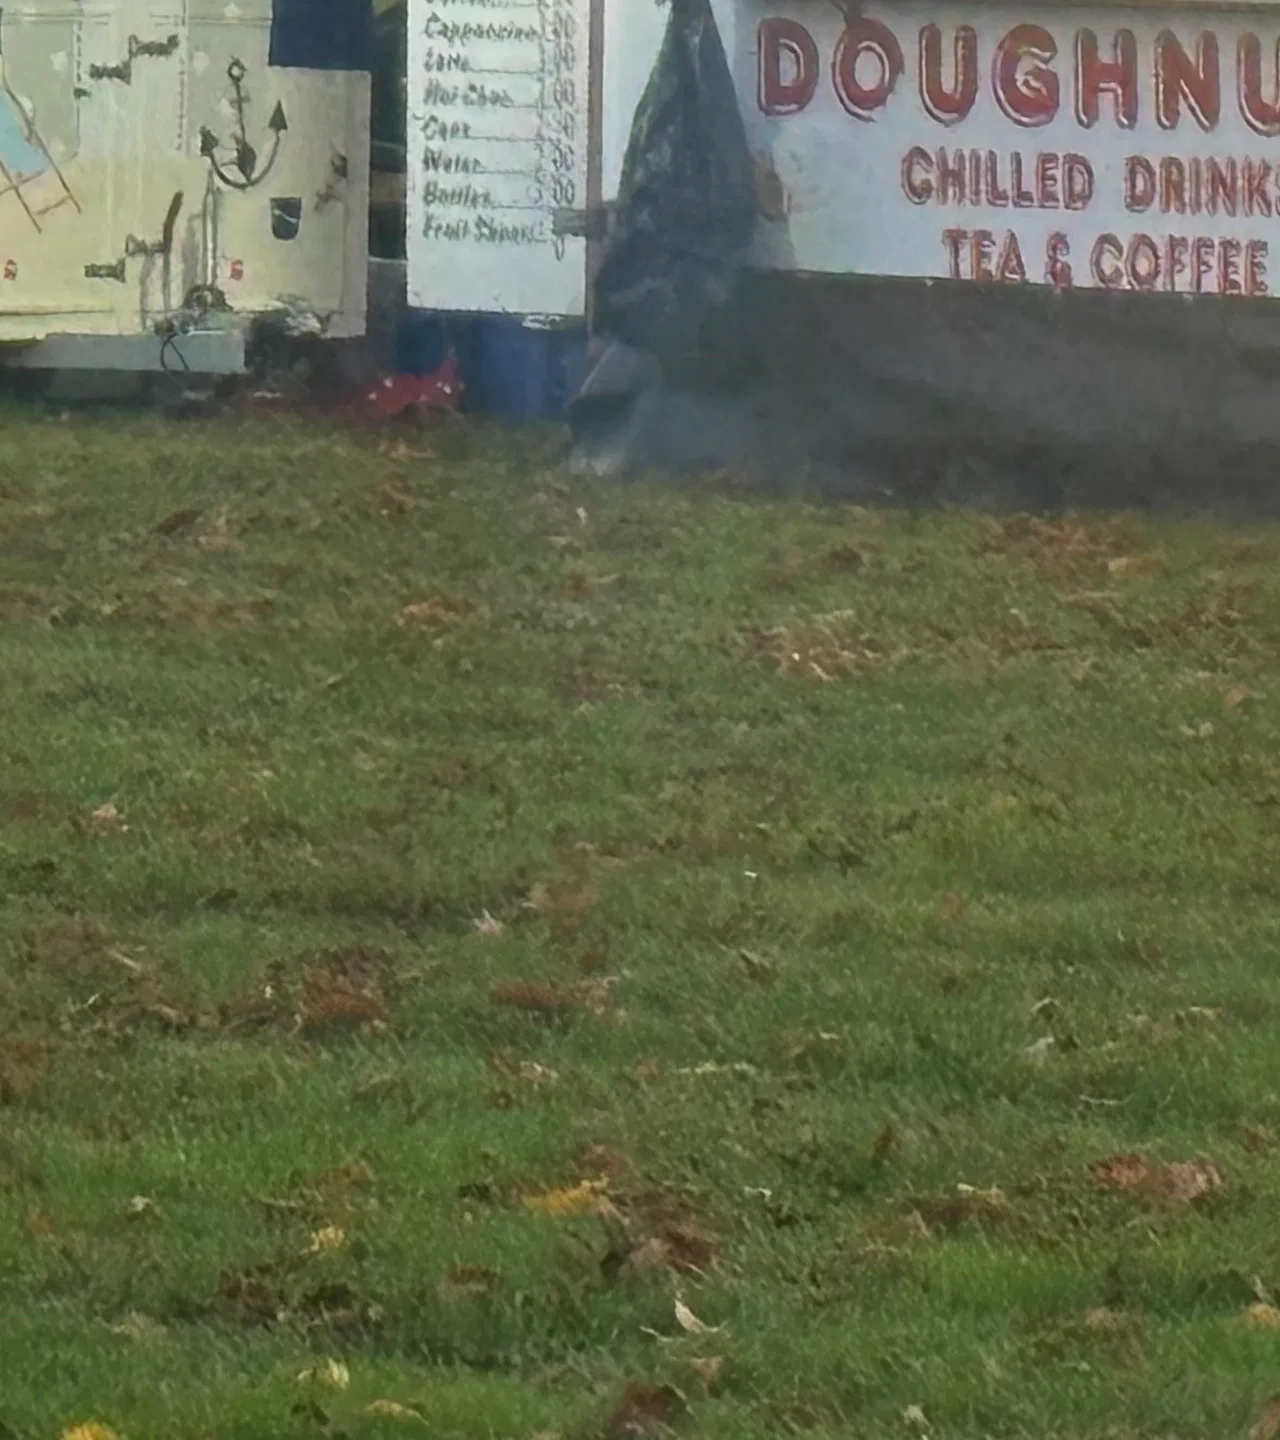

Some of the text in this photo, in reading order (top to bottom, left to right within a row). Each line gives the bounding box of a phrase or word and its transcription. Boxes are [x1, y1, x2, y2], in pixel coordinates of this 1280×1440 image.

[901, 144, 1095, 211] CHILLED
[941, 227, 1269, 295] TEA & COFFEE
